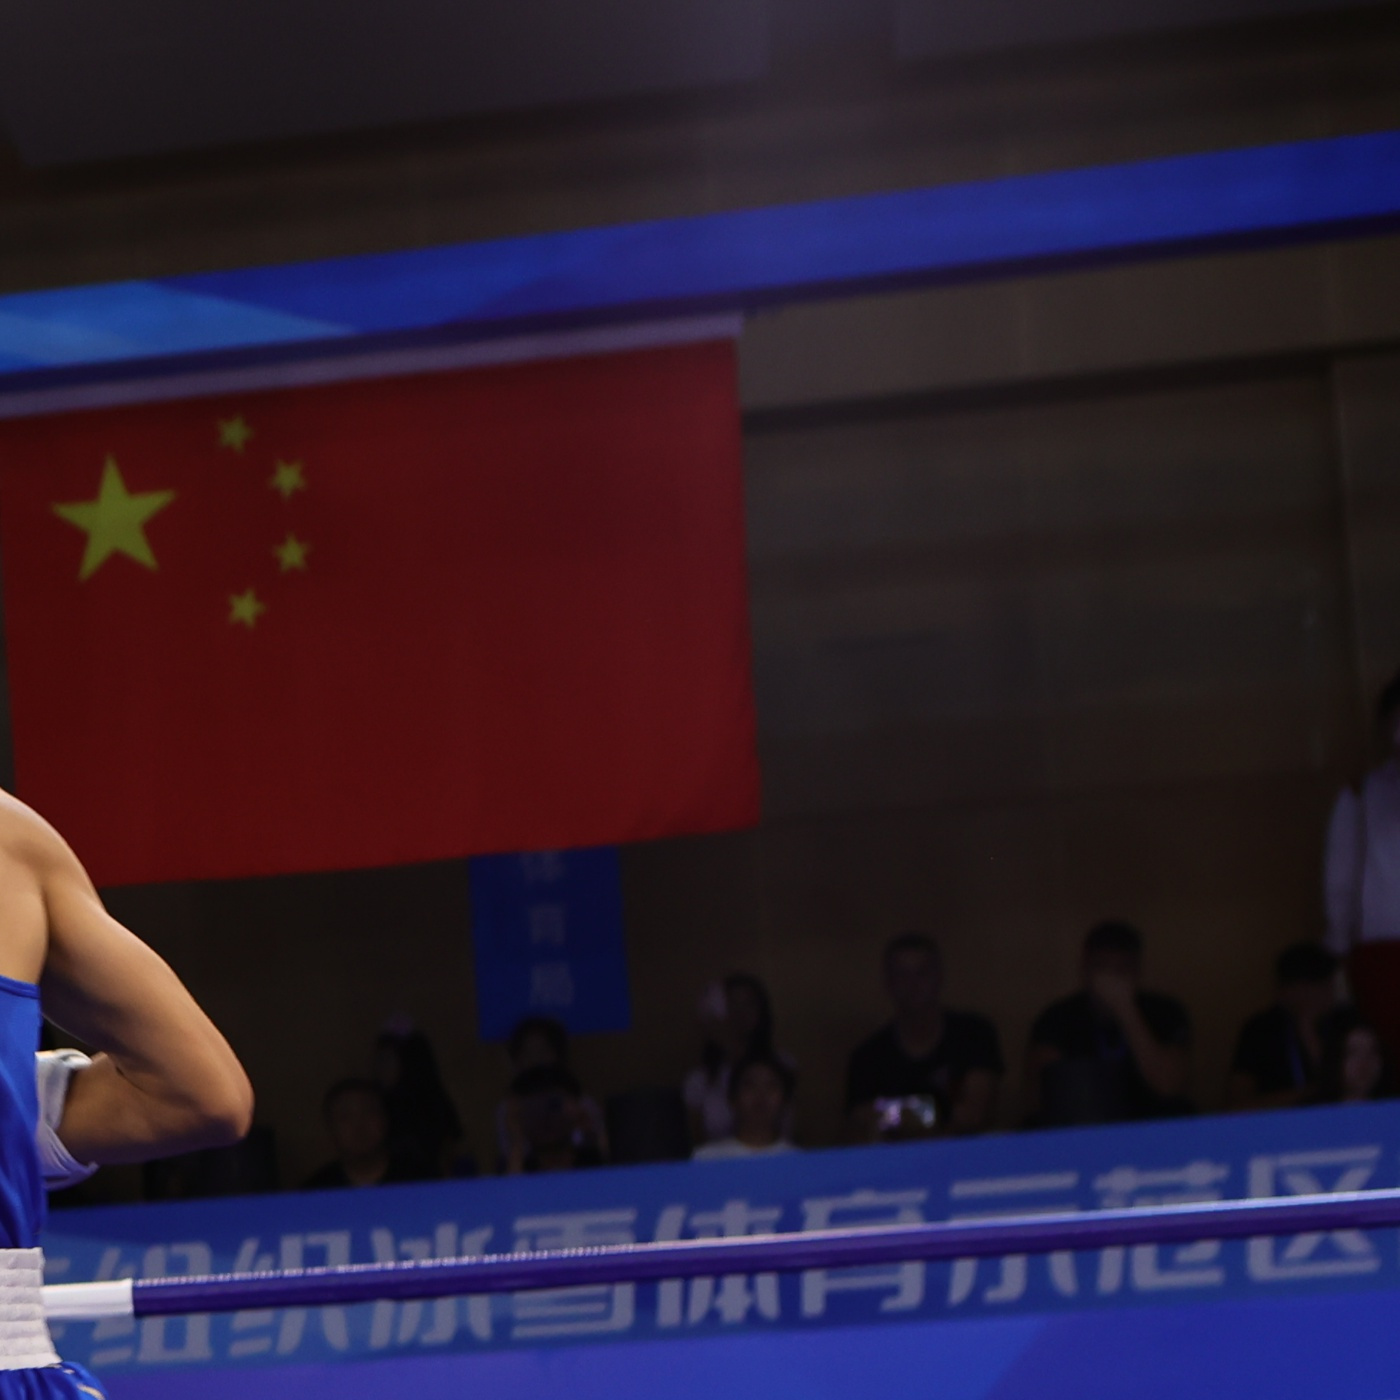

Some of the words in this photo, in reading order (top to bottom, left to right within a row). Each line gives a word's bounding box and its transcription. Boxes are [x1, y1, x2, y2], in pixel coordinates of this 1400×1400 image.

[43, 1145, 1383, 1365] 组织冰雪体育示范区
